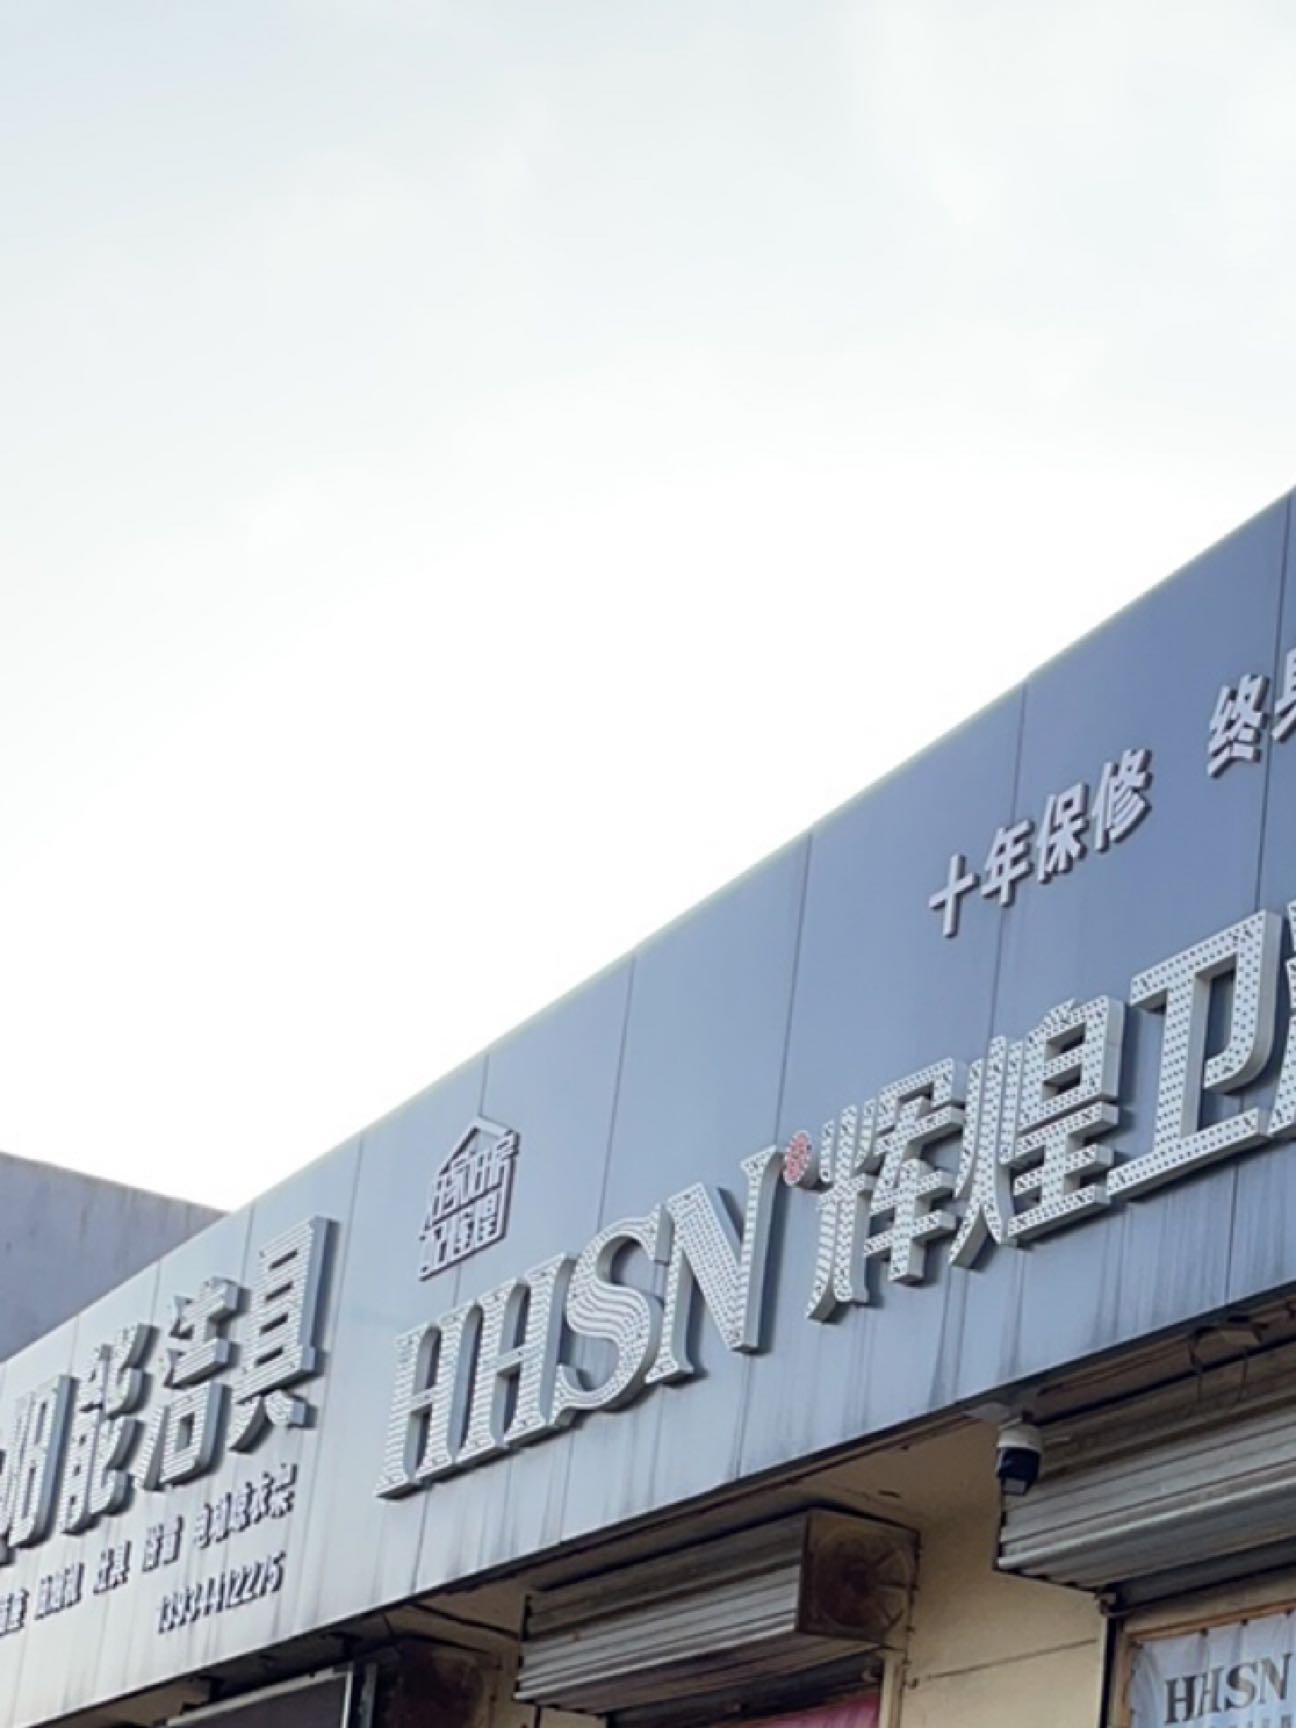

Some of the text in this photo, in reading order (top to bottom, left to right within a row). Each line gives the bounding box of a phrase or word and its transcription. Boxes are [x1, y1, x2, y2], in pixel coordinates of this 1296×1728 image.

[929, 748, 1153, 937] 十年保修
[0, 1216, 340, 1567] 阳能洁具
[374, 1144, 790, 1499] HHSN
[1163, 1652, 1293, 1726] HHSN
